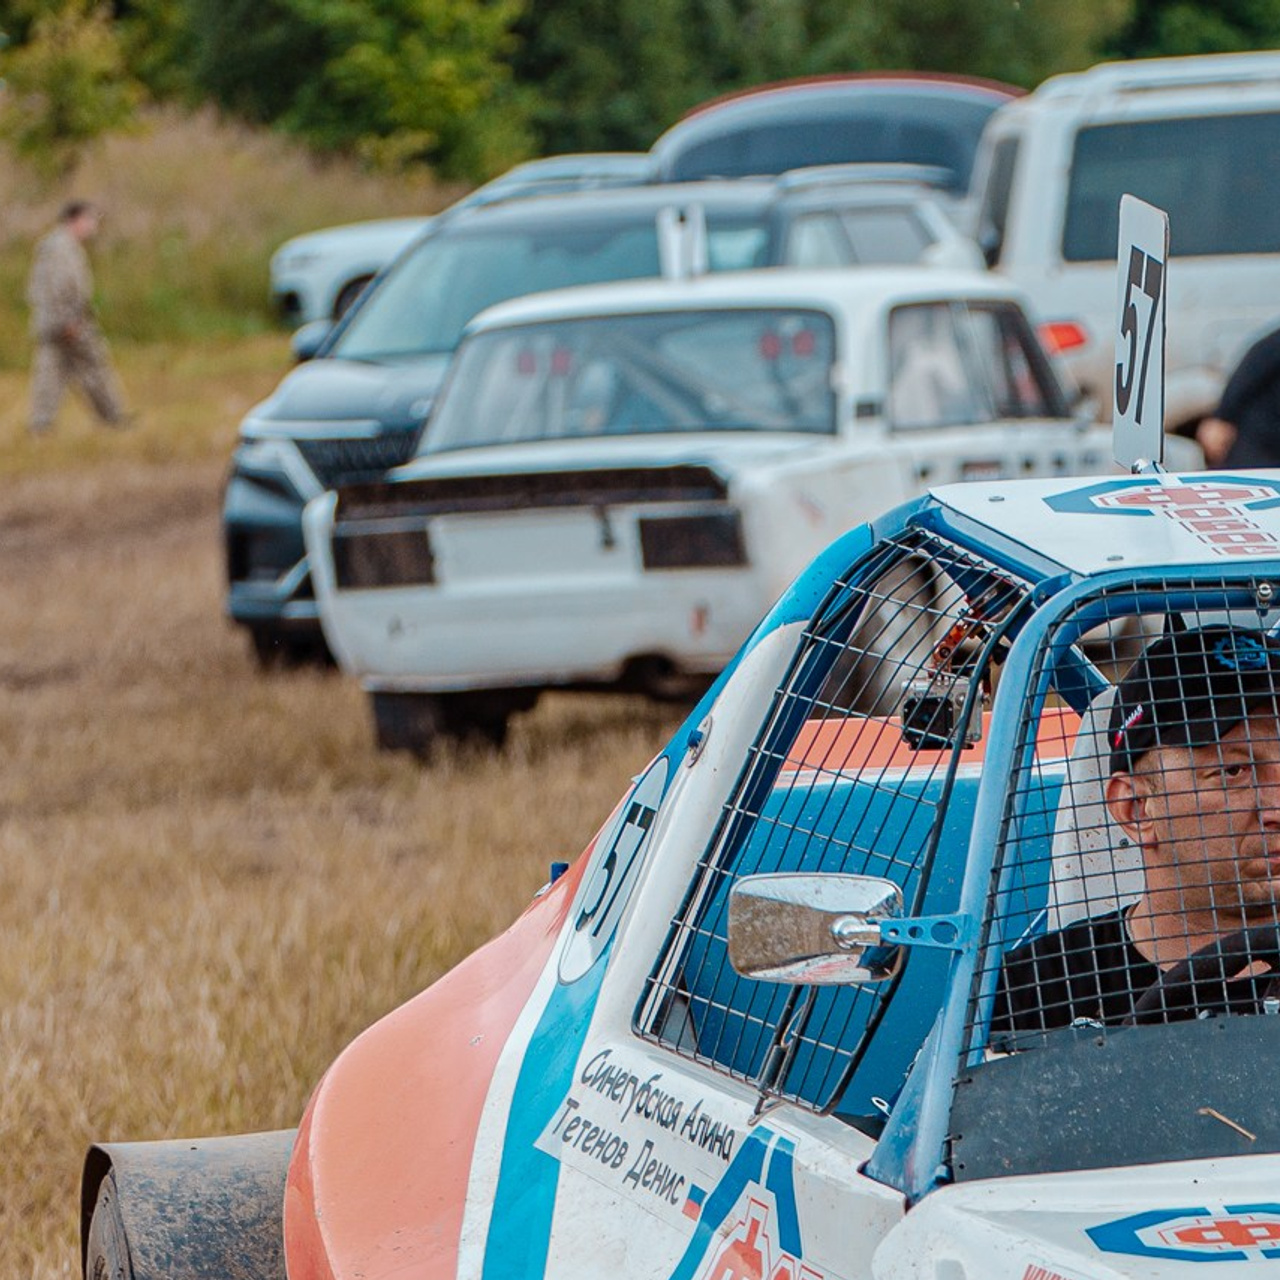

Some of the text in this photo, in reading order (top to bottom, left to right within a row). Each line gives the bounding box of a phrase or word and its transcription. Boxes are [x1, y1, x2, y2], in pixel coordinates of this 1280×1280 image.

[1116, 245, 1163, 424] 57
[575, 801, 656, 937] 57
[553, 1097, 685, 1205] Тетенов Денис
[581, 1049, 736, 1163] Синегубская Алина
